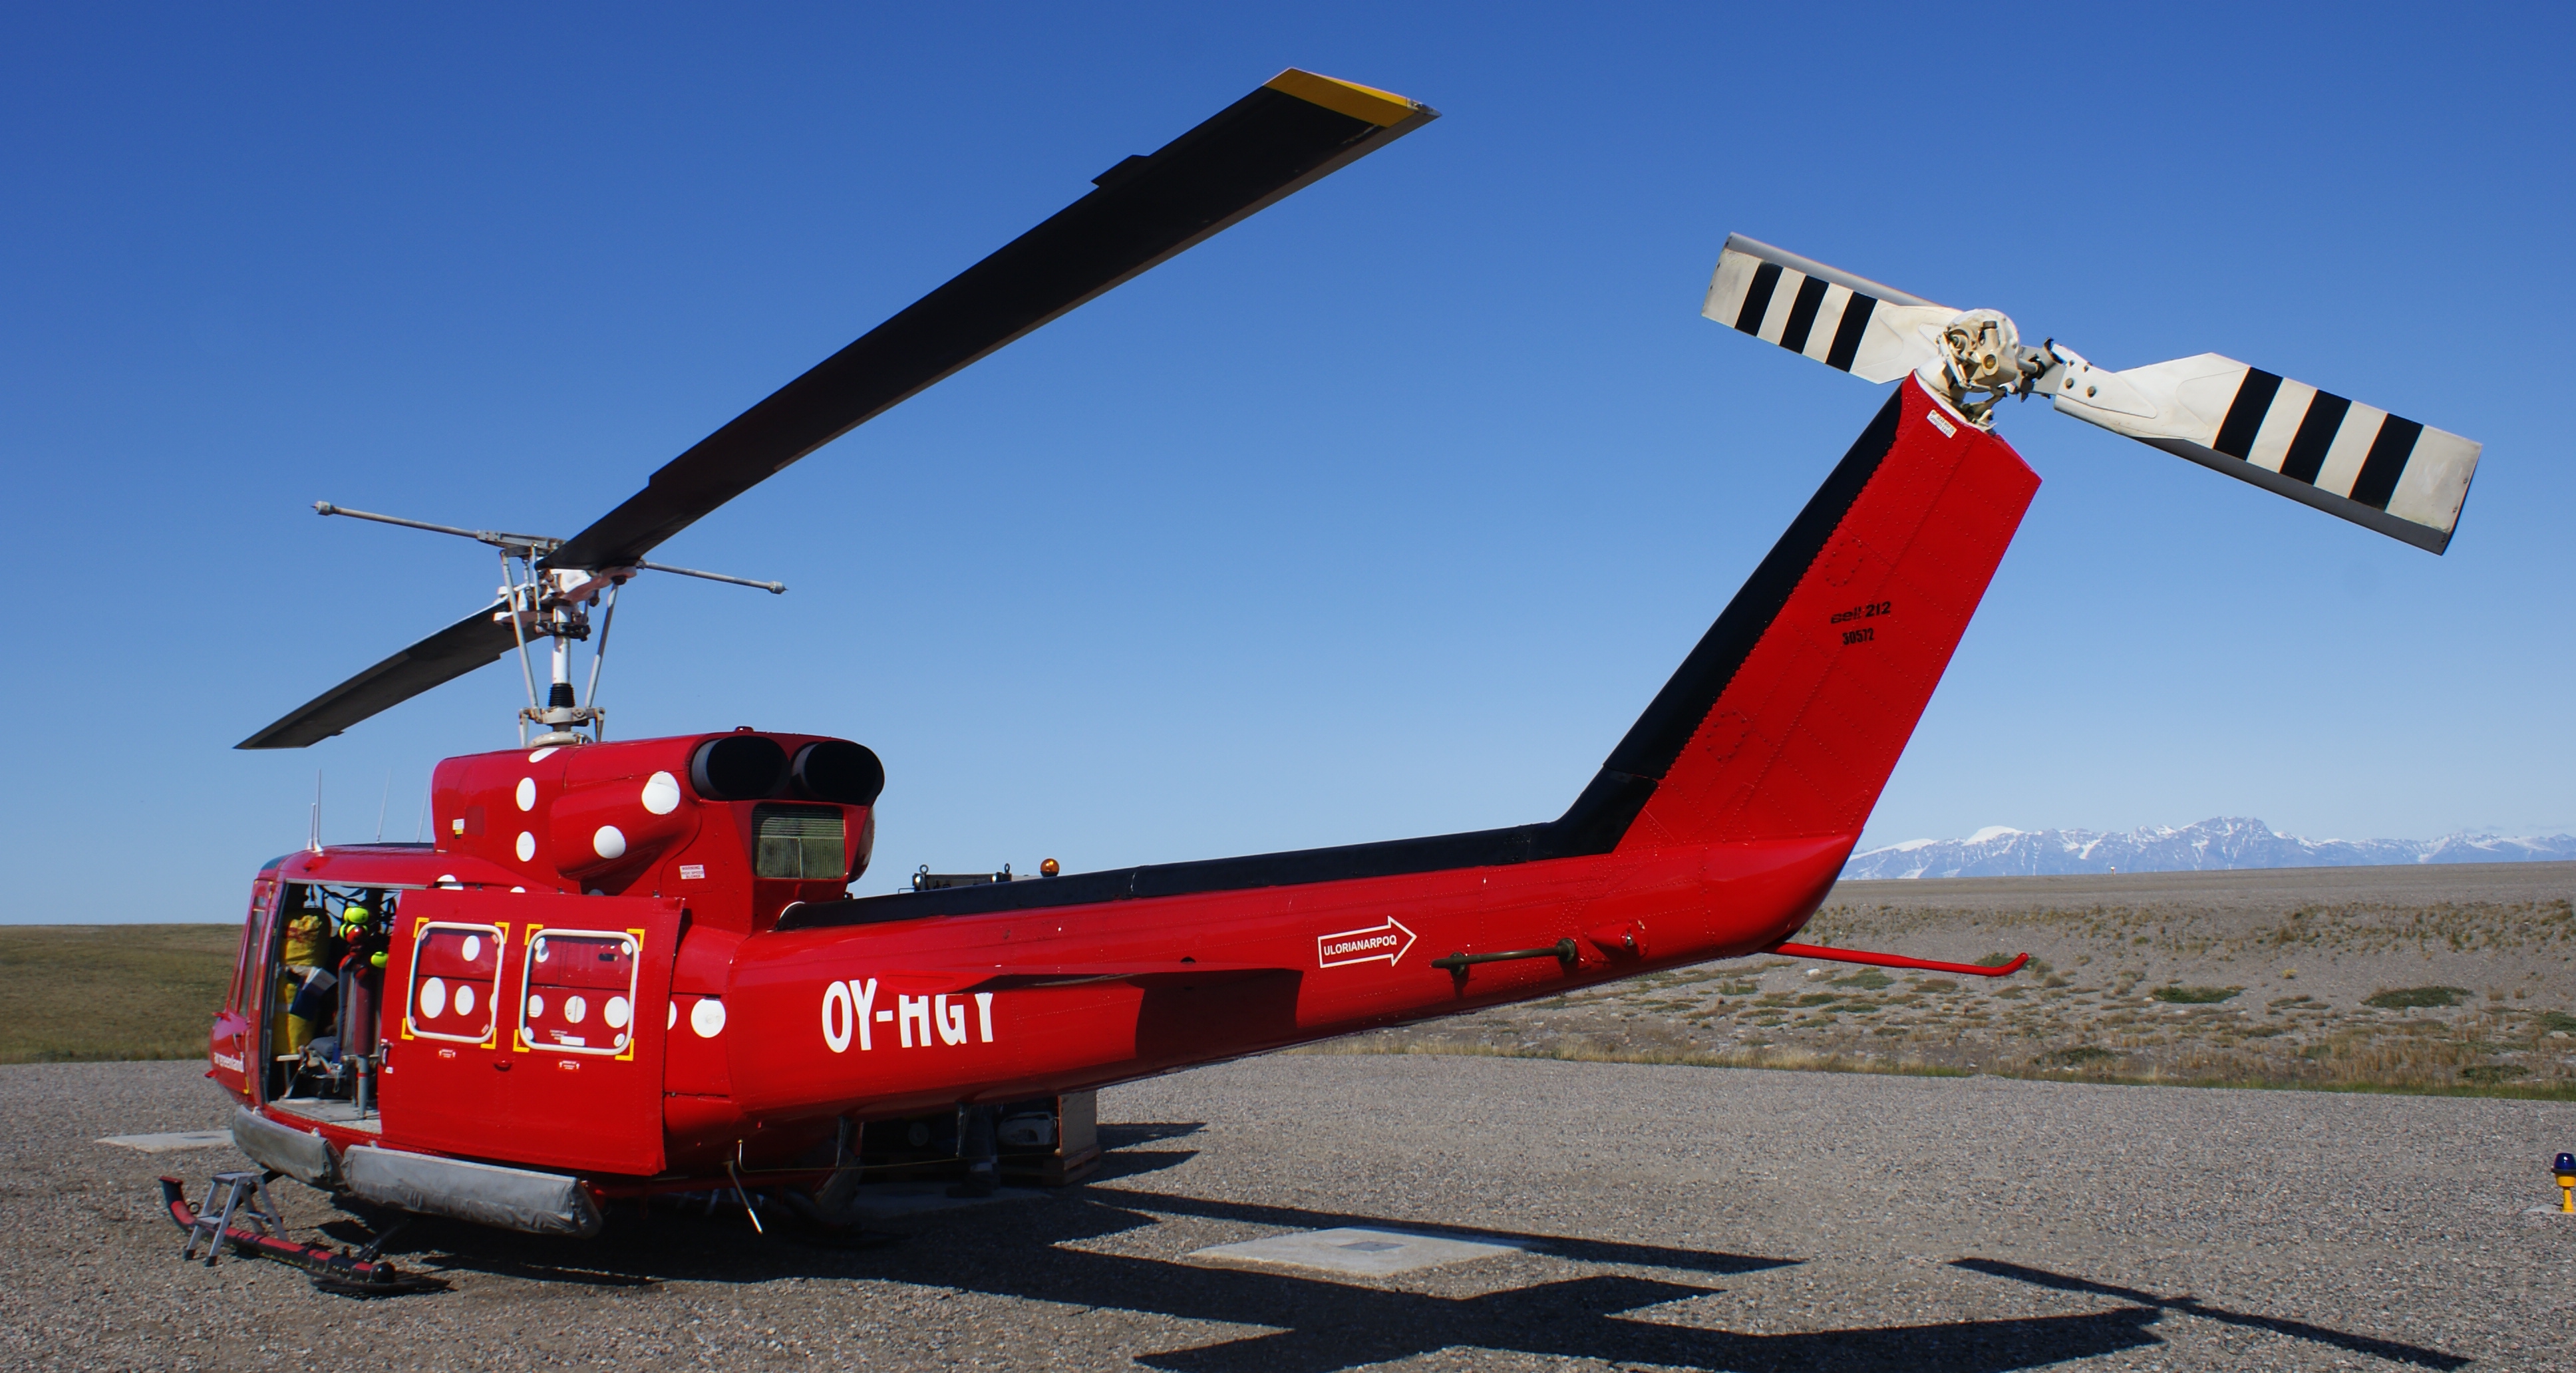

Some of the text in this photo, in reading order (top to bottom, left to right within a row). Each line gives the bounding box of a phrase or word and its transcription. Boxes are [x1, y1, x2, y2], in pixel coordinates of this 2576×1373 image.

[1865, 601, 1891, 617] 212
[1842, 627, 1874, 645] 30572
[1323, 935, 1397, 956] ULORIANARPOQ
[822, 977, 994, 1054] OY-HGY
